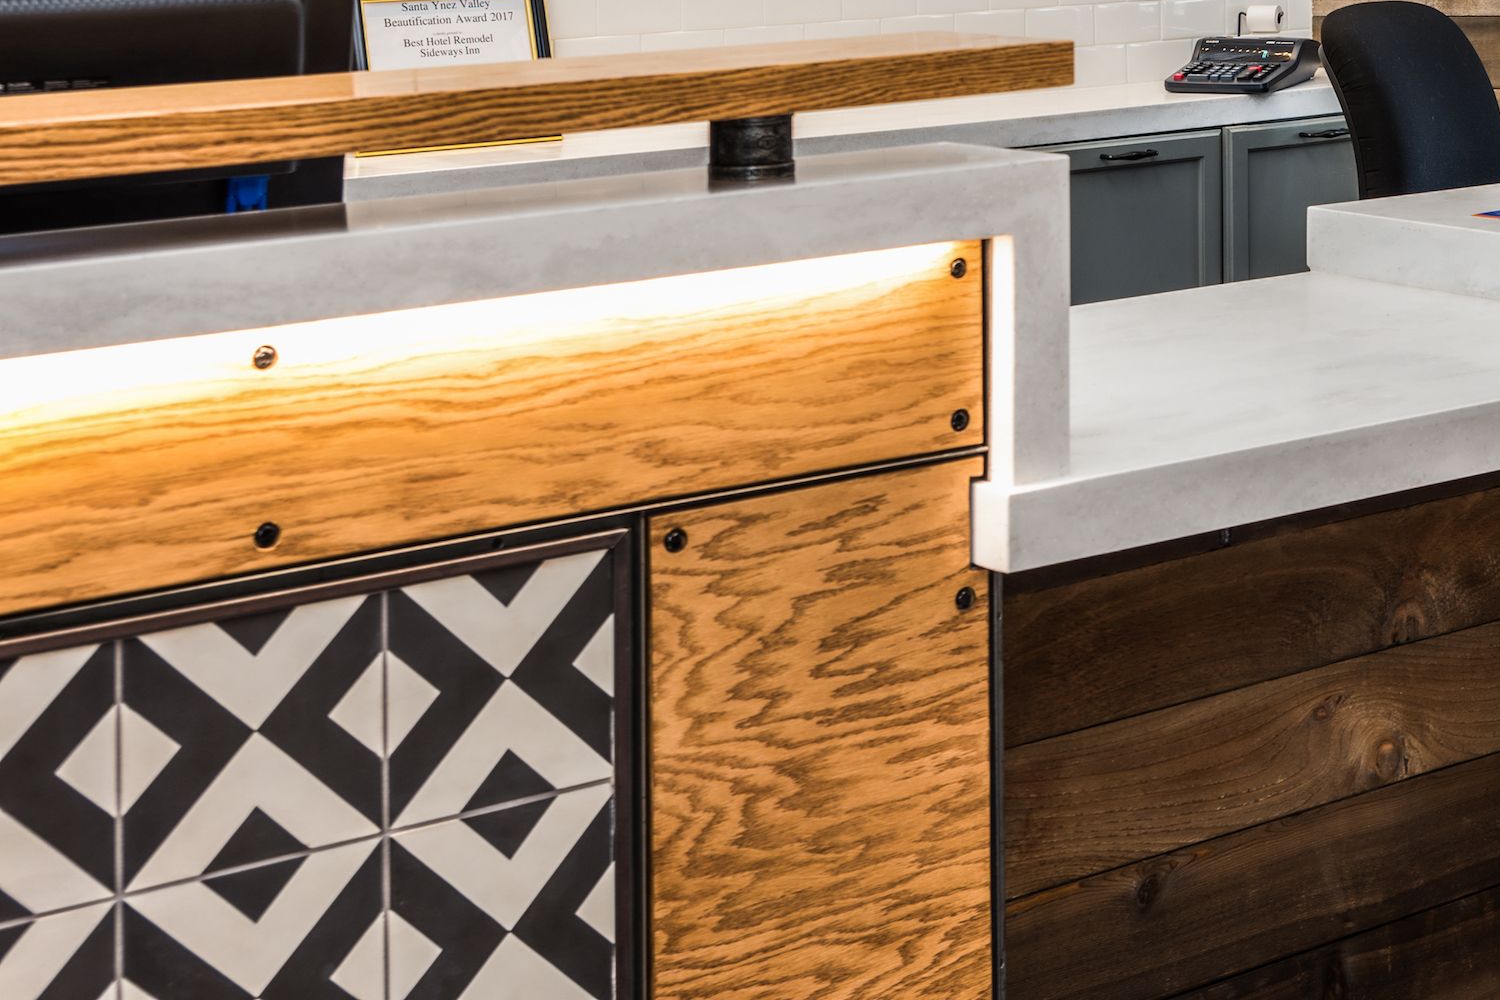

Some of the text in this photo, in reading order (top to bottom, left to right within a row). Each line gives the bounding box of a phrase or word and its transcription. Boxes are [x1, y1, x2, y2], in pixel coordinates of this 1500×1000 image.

[401, 0, 429, 12] Santa
[431, 0, 457, 11] Ynez
[384, 11, 514, 28] Beautification Award 2017
[403, 38, 423, 48] Best
[426, 36, 451, 46] Hotel
[453, 33, 494, 45] Remodel
[420, 46, 481, 58] Sideways Inn
